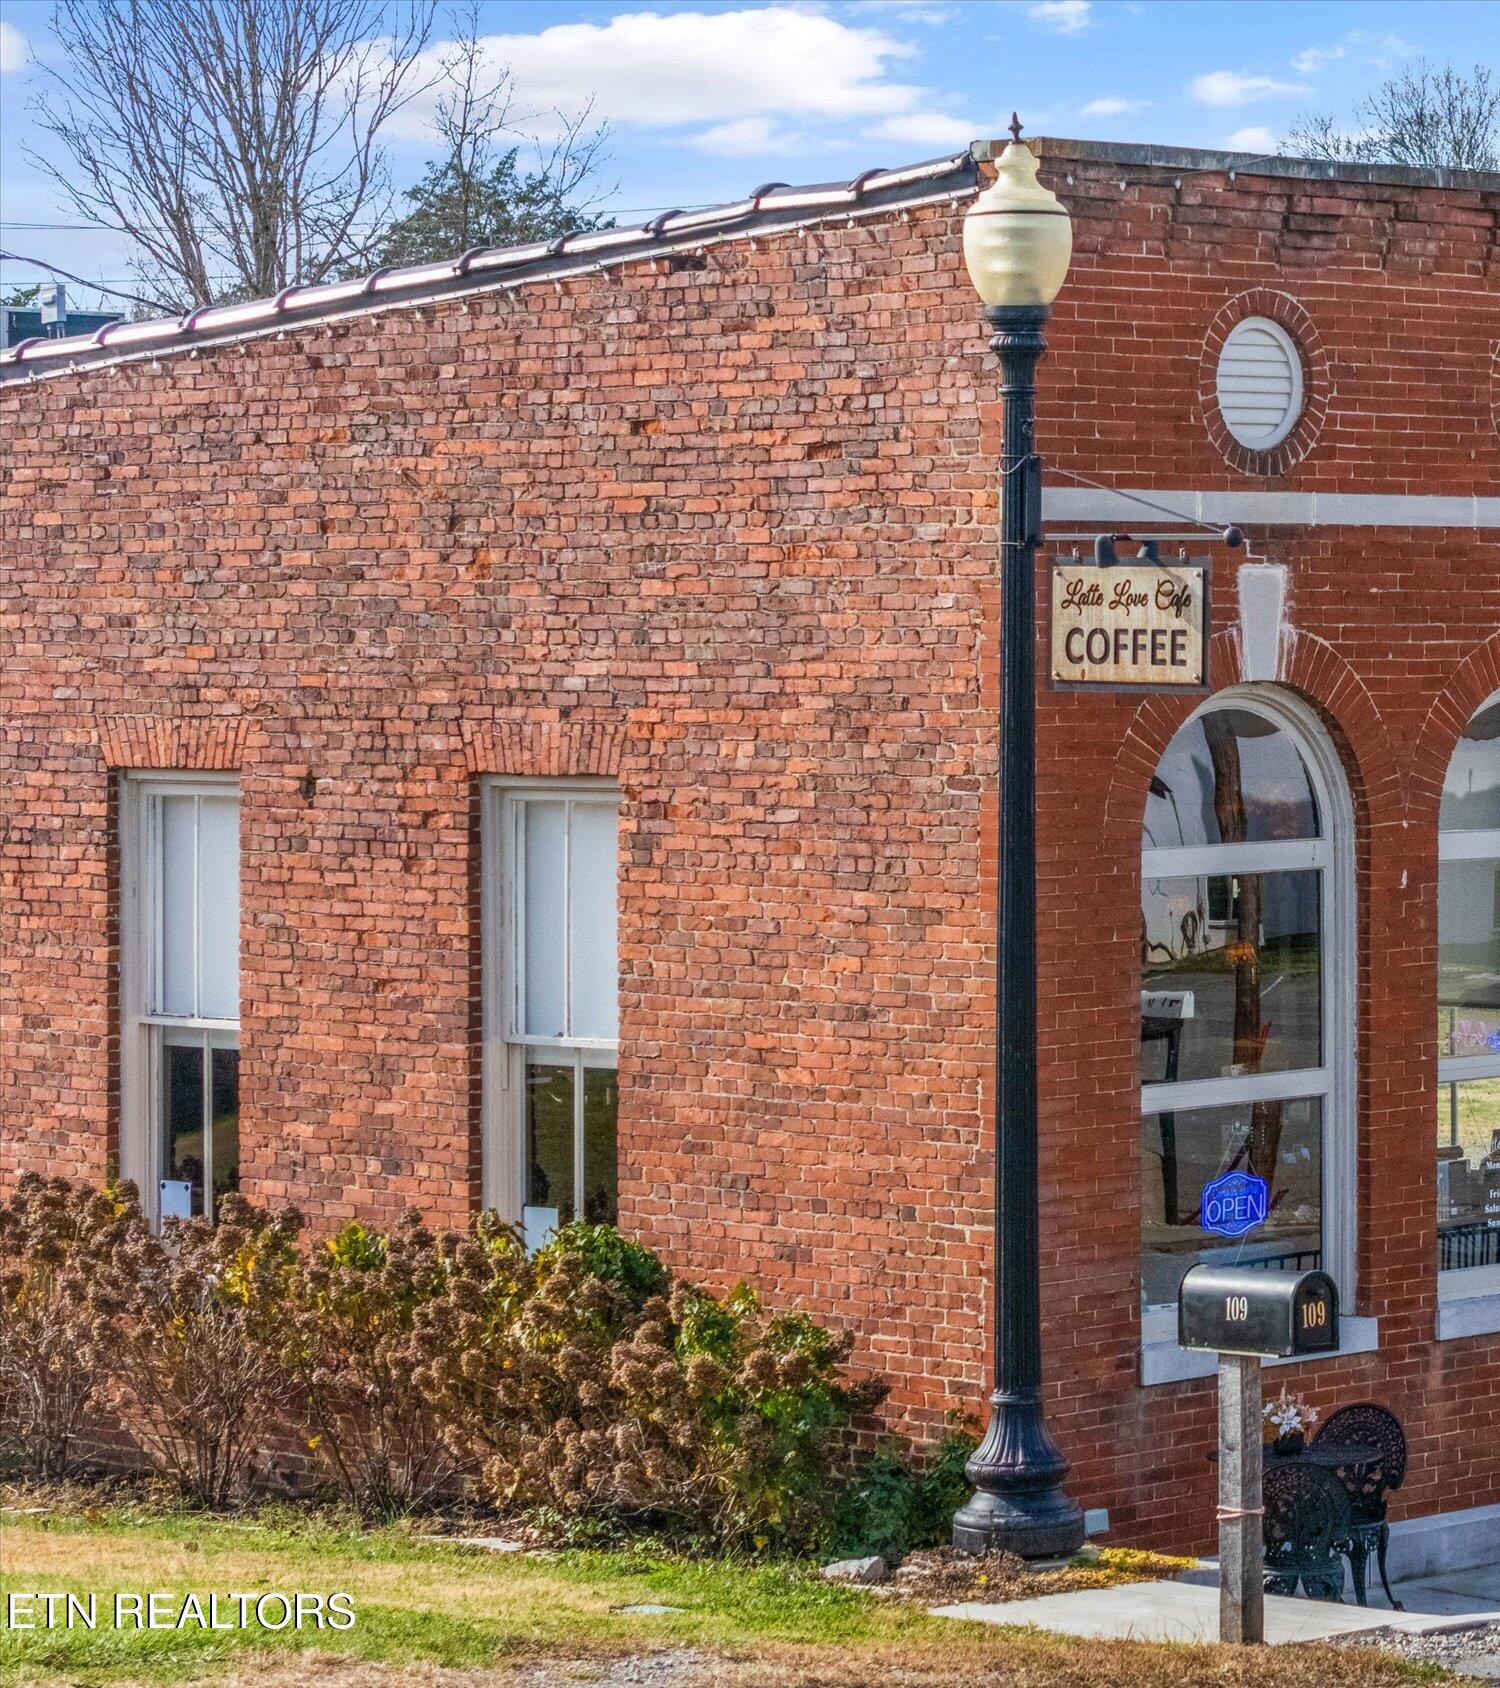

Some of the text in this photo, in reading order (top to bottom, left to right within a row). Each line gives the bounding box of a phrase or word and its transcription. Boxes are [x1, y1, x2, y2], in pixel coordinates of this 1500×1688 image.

[1061, 579, 1191, 618] Latte Love Cafe
[1065, 627, 1187, 666] COFFEE
[1207, 1193, 1263, 1222] OPEN
[1225, 1296, 1248, 1321] 109
[1302, 1301, 1326, 1328] 109
